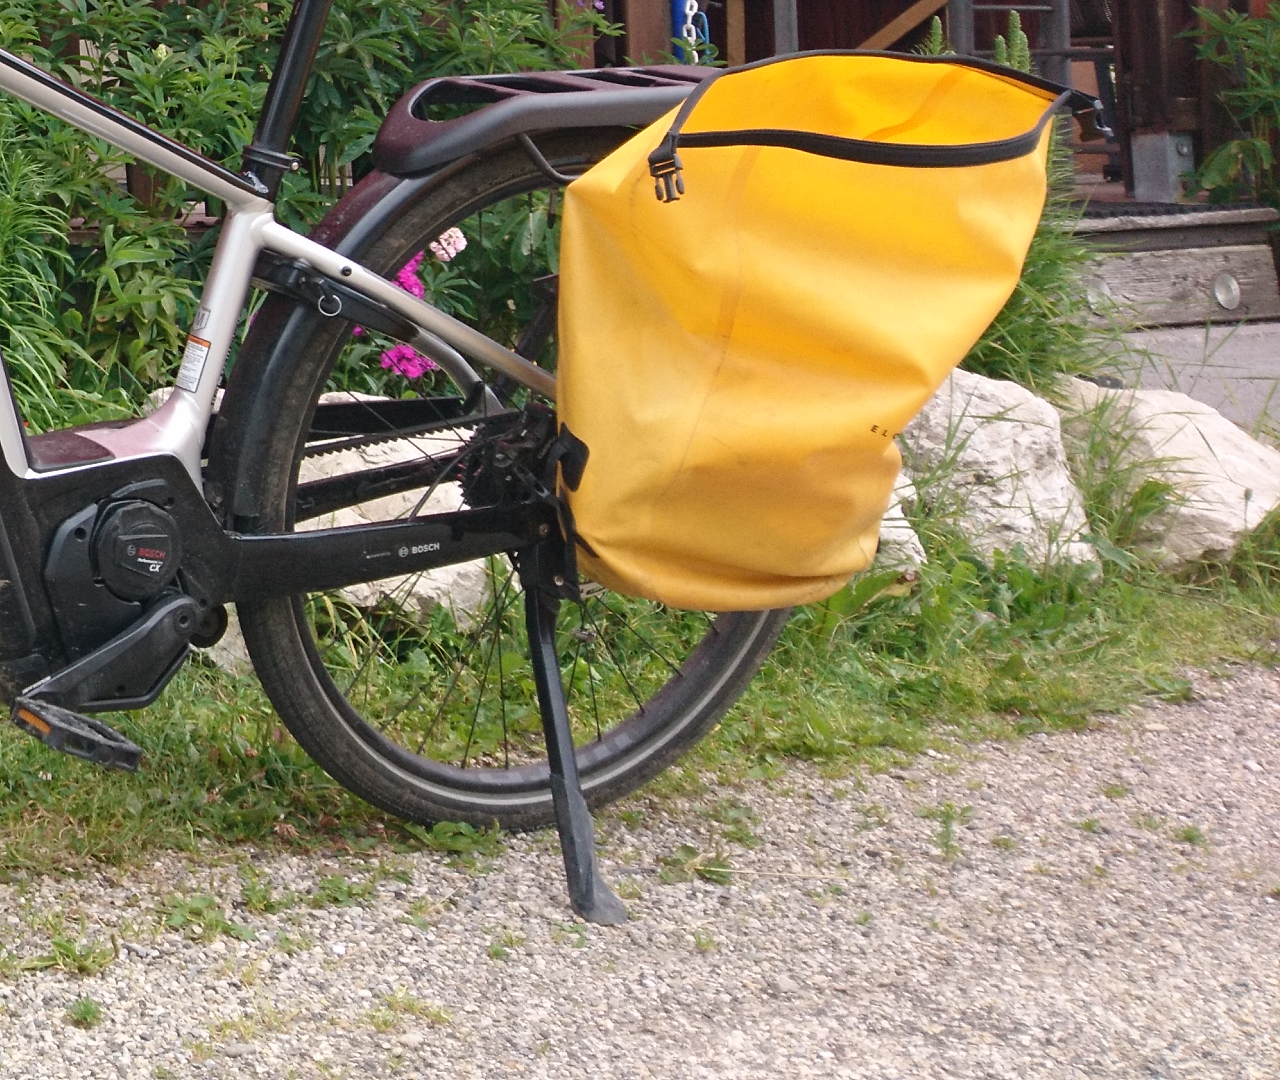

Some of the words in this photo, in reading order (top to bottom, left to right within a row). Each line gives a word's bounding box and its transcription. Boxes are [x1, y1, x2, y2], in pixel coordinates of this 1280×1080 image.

[138, 547, 166, 559] BOSCH
[411, 542, 440, 555] BOSCH
[149, 564, 162, 573] CX
